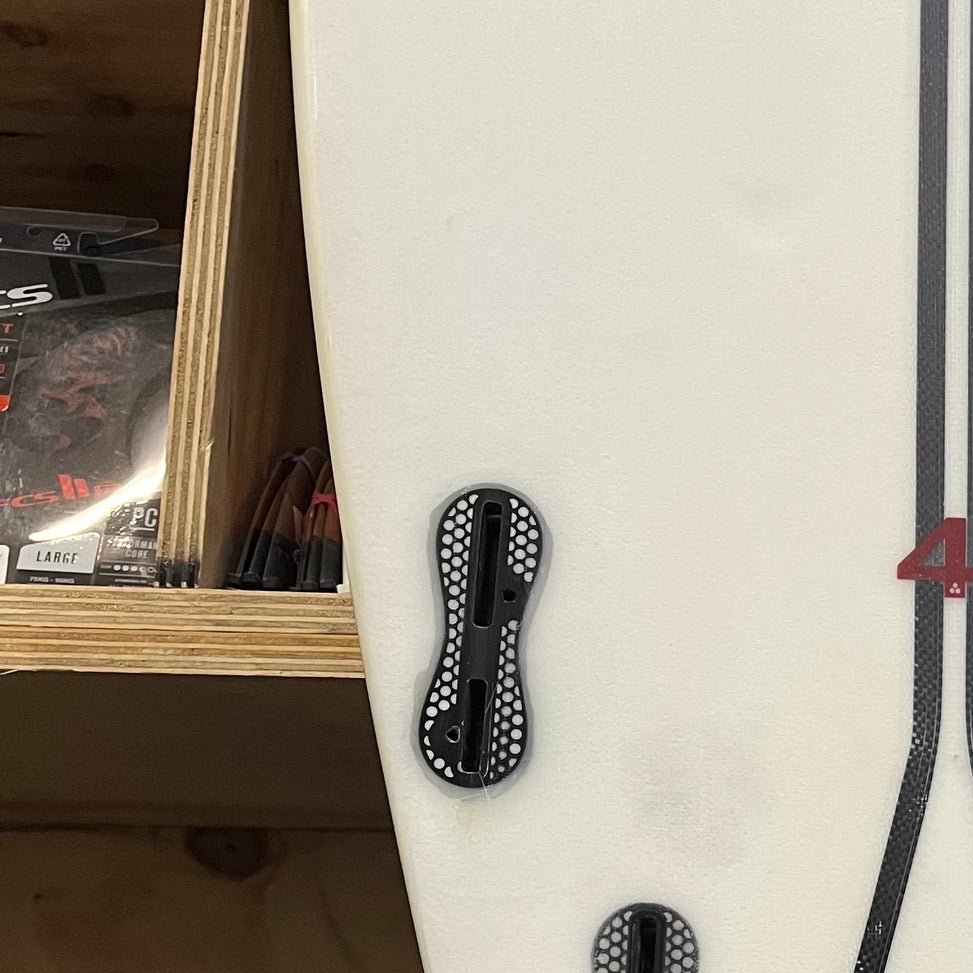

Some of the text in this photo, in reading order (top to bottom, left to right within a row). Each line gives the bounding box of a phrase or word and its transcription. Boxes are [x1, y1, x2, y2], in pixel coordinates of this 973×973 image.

[0, 284, 53, 310] S
[0, 490, 59, 508] CS
[36, 550, 78, 565] LARGE
